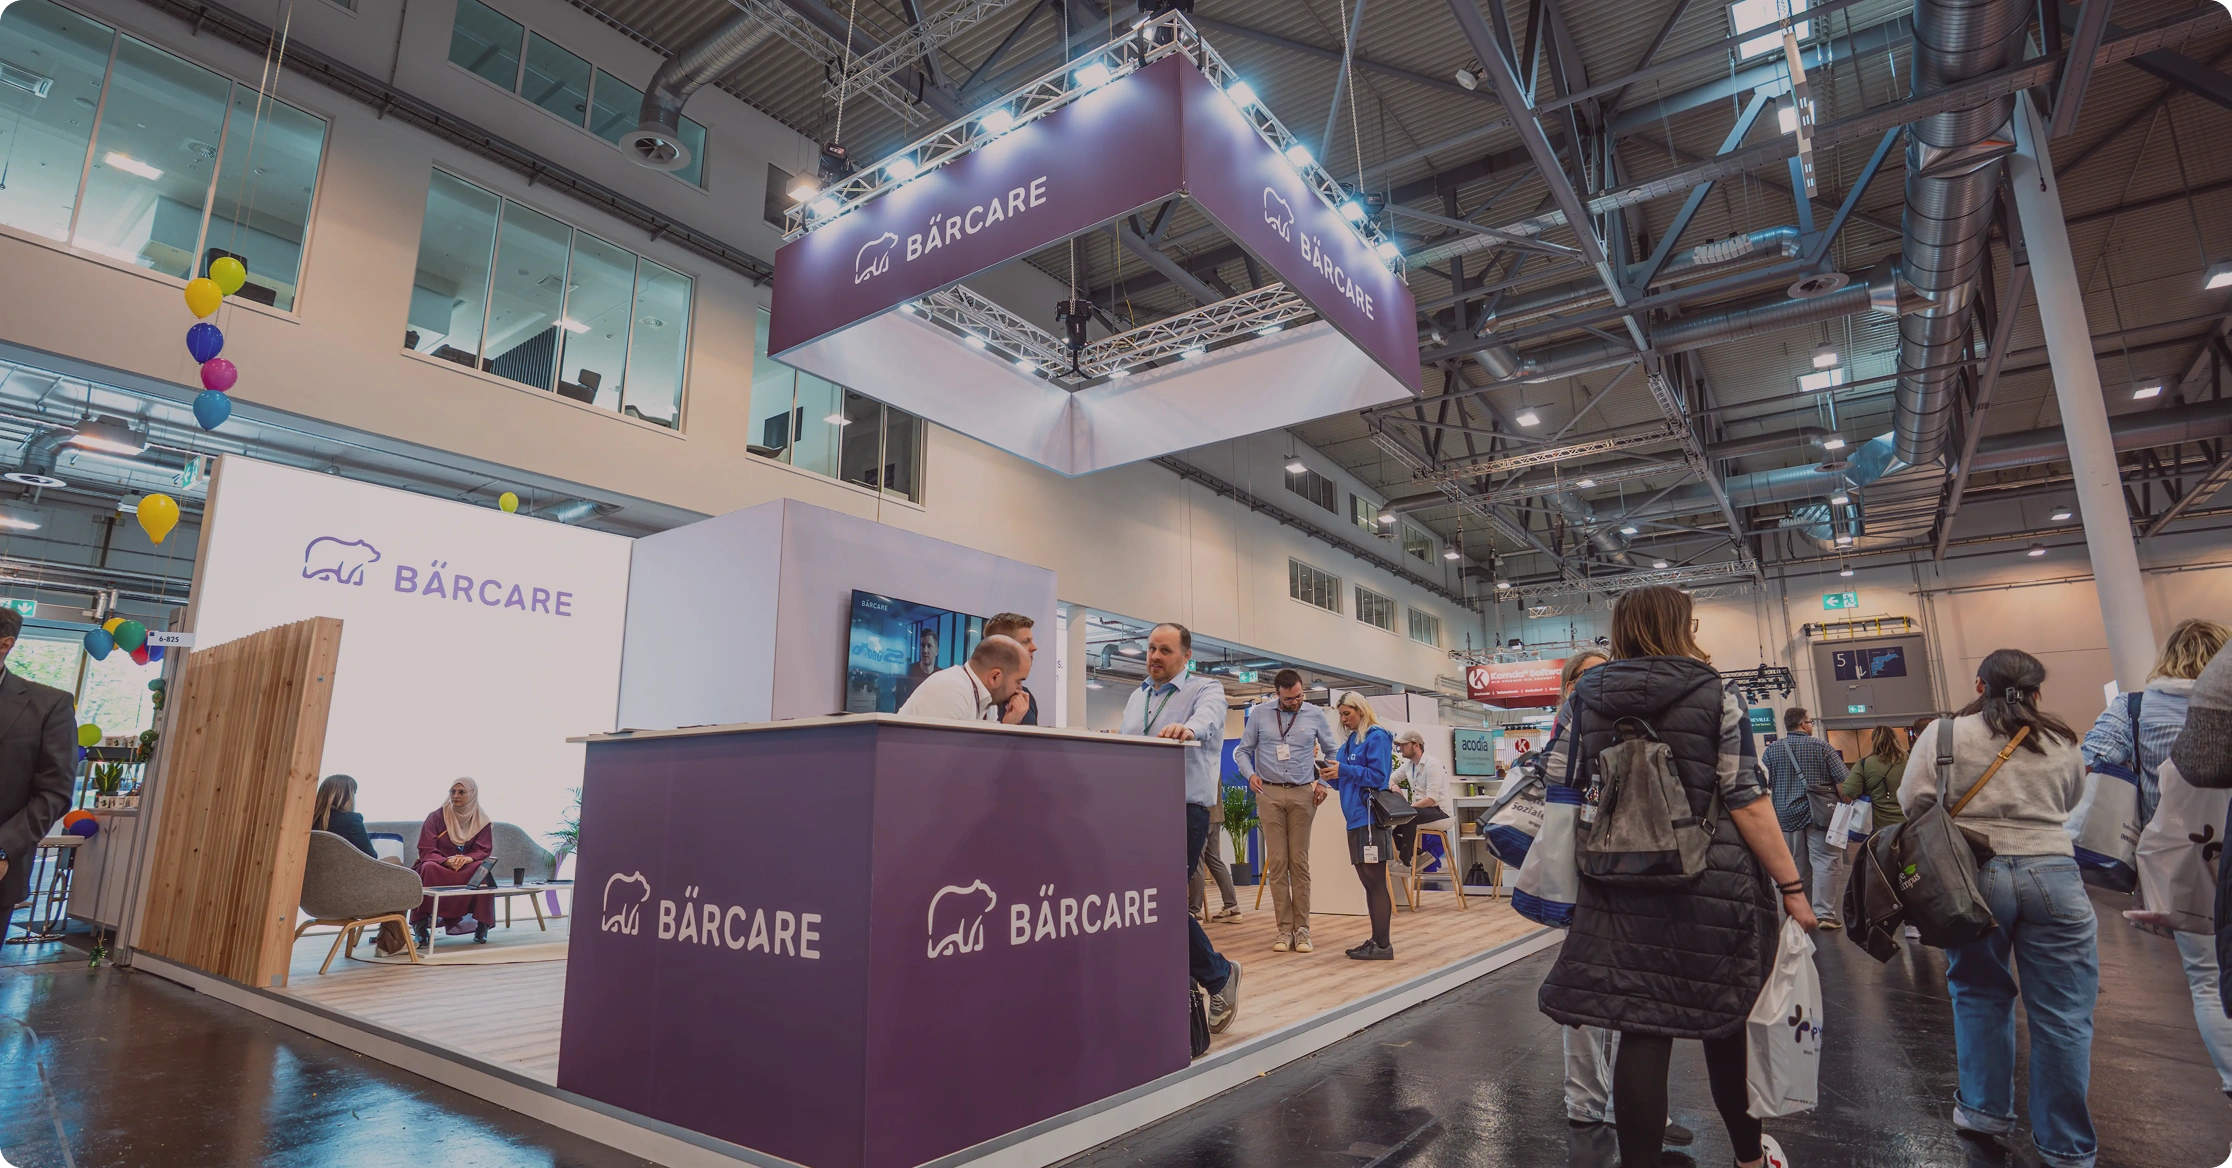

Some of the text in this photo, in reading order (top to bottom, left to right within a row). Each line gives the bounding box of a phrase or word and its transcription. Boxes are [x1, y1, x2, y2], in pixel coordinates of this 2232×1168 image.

[906, 176, 1047, 262] BÄRCARE
[1300, 232, 1374, 321] BÄRCARE
[394, 559, 573, 617] BÄRCARE
[861, 600, 889, 612] BÄRCARE
[158, 635, 180, 643] 6-825
[1836, 653, 1846, 667] 5
[1461, 736, 1488, 752] acodia
[658, 885, 822, 960] BÄRCARE
[1010, 883, 1158, 946] BÄRCARE
